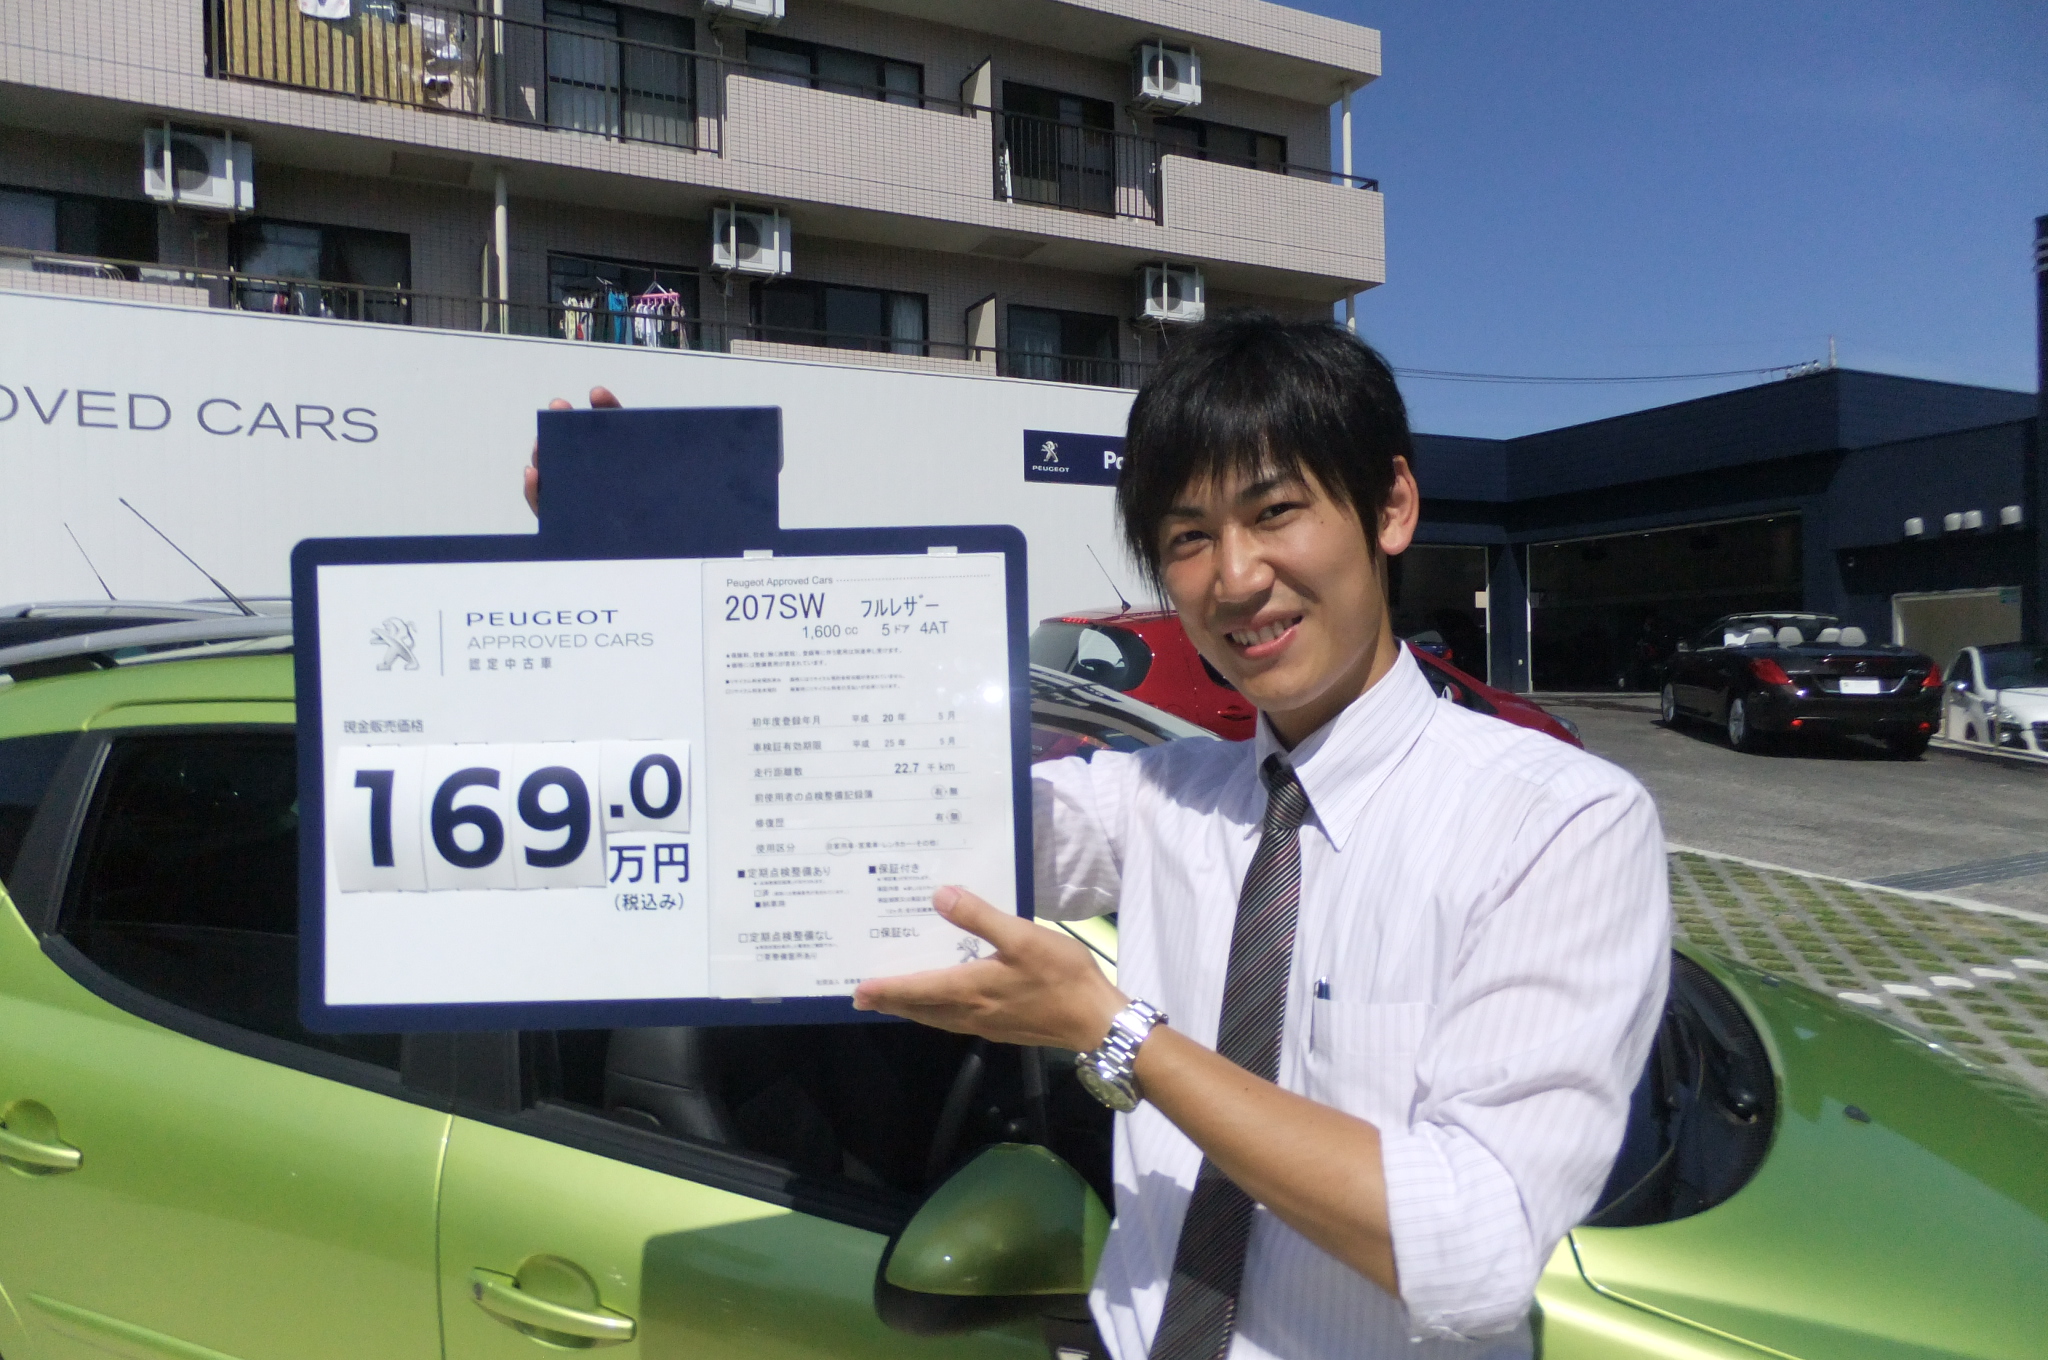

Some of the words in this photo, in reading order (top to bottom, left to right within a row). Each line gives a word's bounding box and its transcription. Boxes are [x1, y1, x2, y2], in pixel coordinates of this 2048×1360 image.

[197, 398, 378, 443] CARS
[1032, 464, 1070, 473] PEUGEOT
[726, 578, 765, 590] Peugeot
[765, 576, 810, 588] Approved
[811, 575, 834, 585] Cars
[726, 593, 825, 621] 207SW
[467, 610, 617, 626] PEUGEOT
[802, 624, 842, 640] 1,600
[844, 626, 859, 636] cc
[881, 622, 891, 637] 5
[919, 620, 949, 635] 4AT
[466, 633, 588, 650] APPROVED
[594, 631, 655, 648] CARS
[882, 713, 894, 724] 20
[894, 762, 920, 775] 22.7
[937, 761, 956, 772] km
[609, 842, 690, 884] 万円
